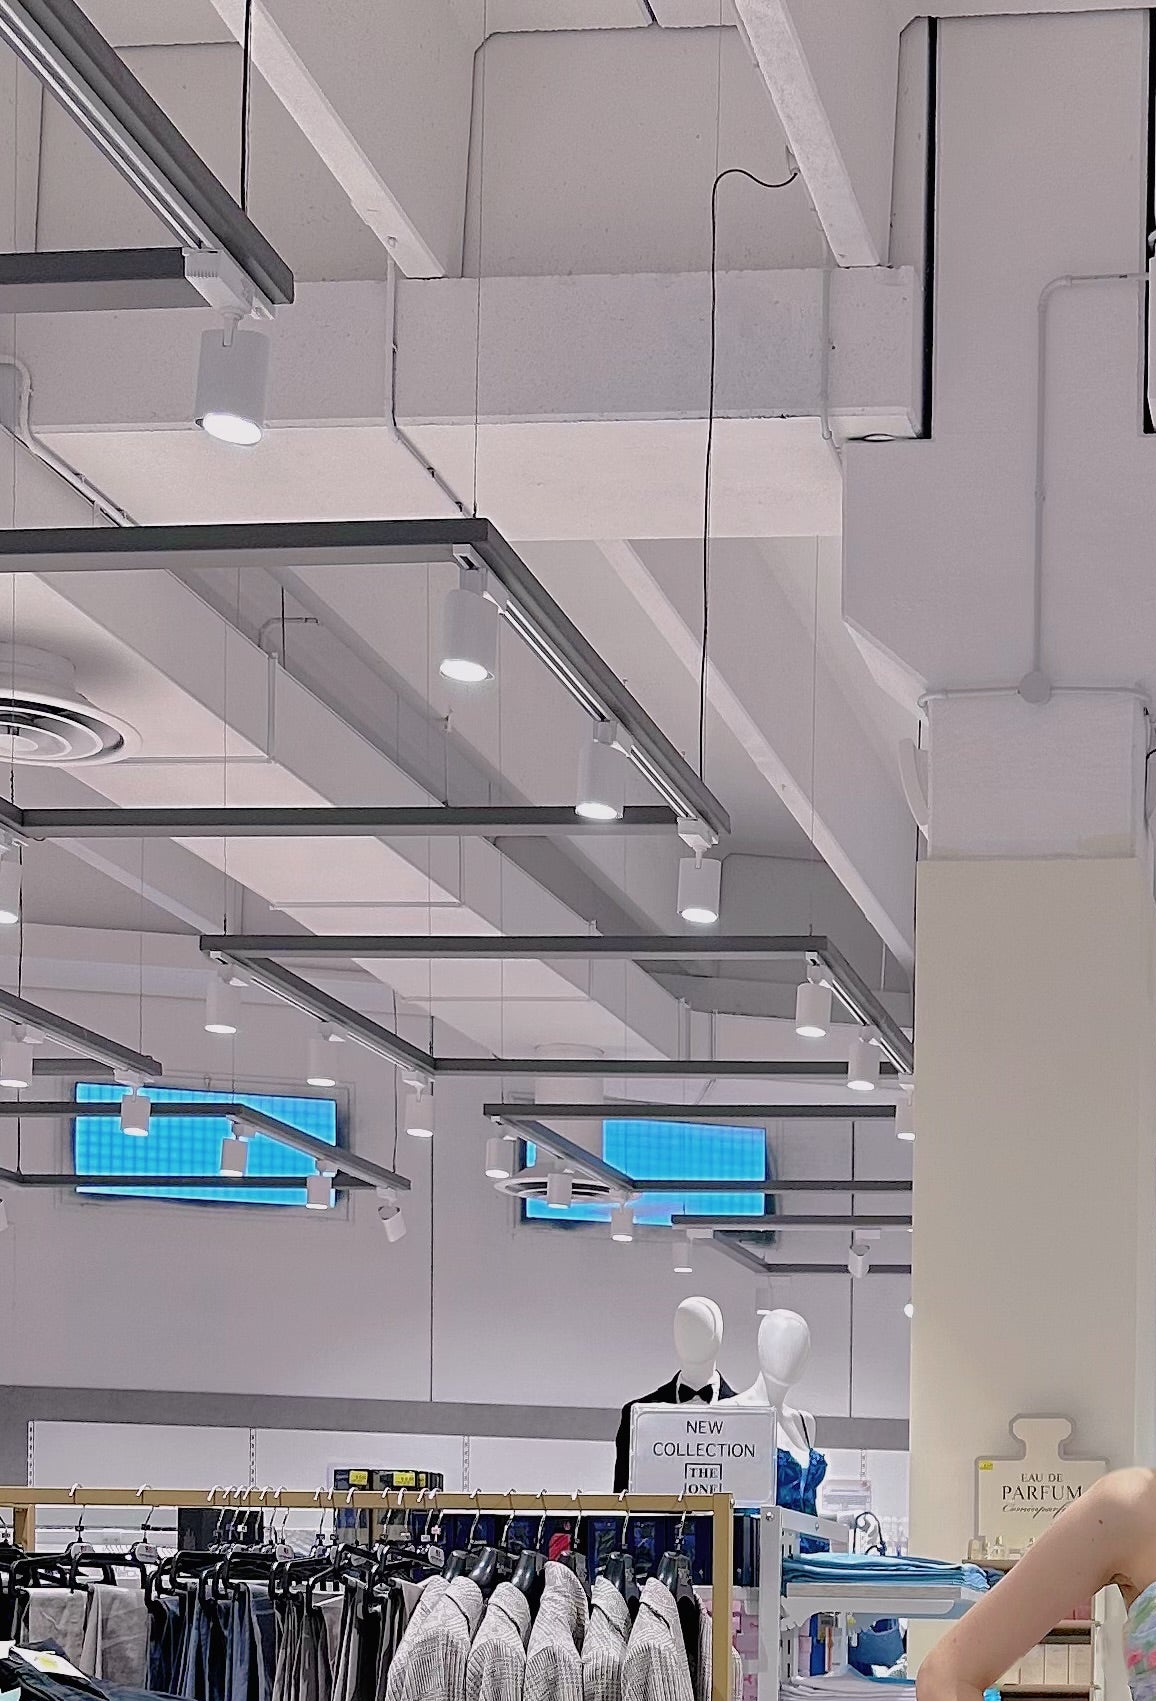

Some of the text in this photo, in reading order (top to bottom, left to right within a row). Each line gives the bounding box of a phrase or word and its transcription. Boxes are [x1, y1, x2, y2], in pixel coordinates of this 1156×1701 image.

[686, 1420, 724, 1434] NEW
[653, 1442, 755, 1458] COLLECTION
[689, 1467, 719, 1479] THE
[1021, 1473, 1063, 1483] EAU DE
[688, 1483, 718, 1494] ONE
[1002, 1485, 1083, 1500] PARFUM
